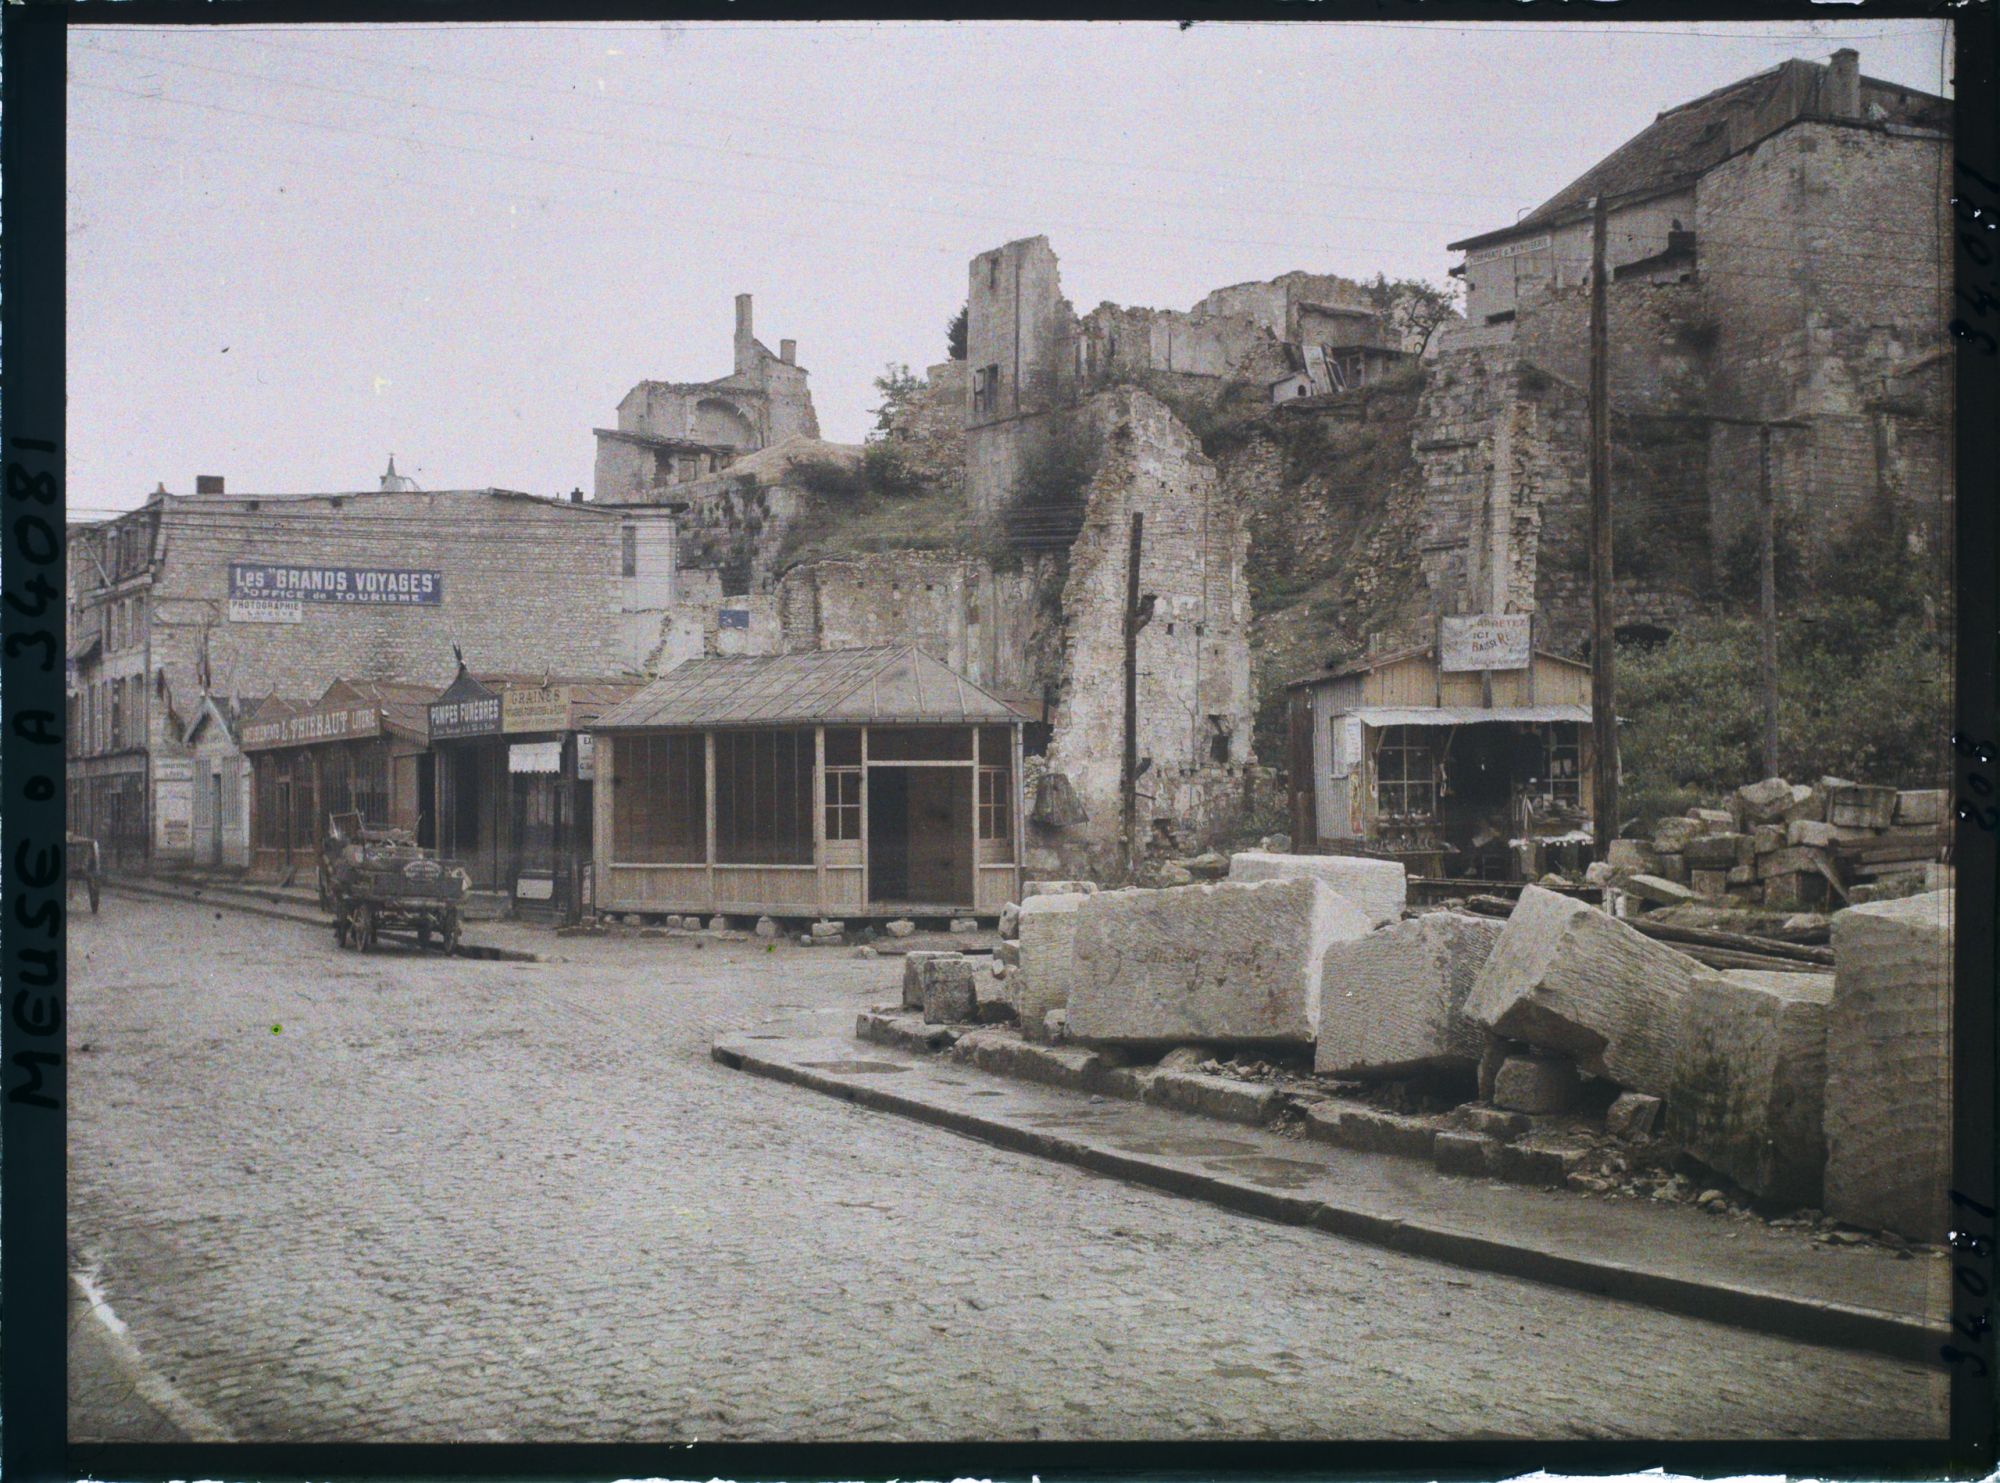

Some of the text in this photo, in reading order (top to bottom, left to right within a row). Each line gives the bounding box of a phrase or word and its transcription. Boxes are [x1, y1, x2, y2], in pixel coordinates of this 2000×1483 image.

[235, 567, 441, 593] Les "GRANDS VOYAGES"
[335, 592, 420, 602] TOURISME
[232, 601, 298, 610] PHOTOGRAPHIE
[511, 689, 560, 705] GRAINES
[431, 704, 459, 726] POMPES
